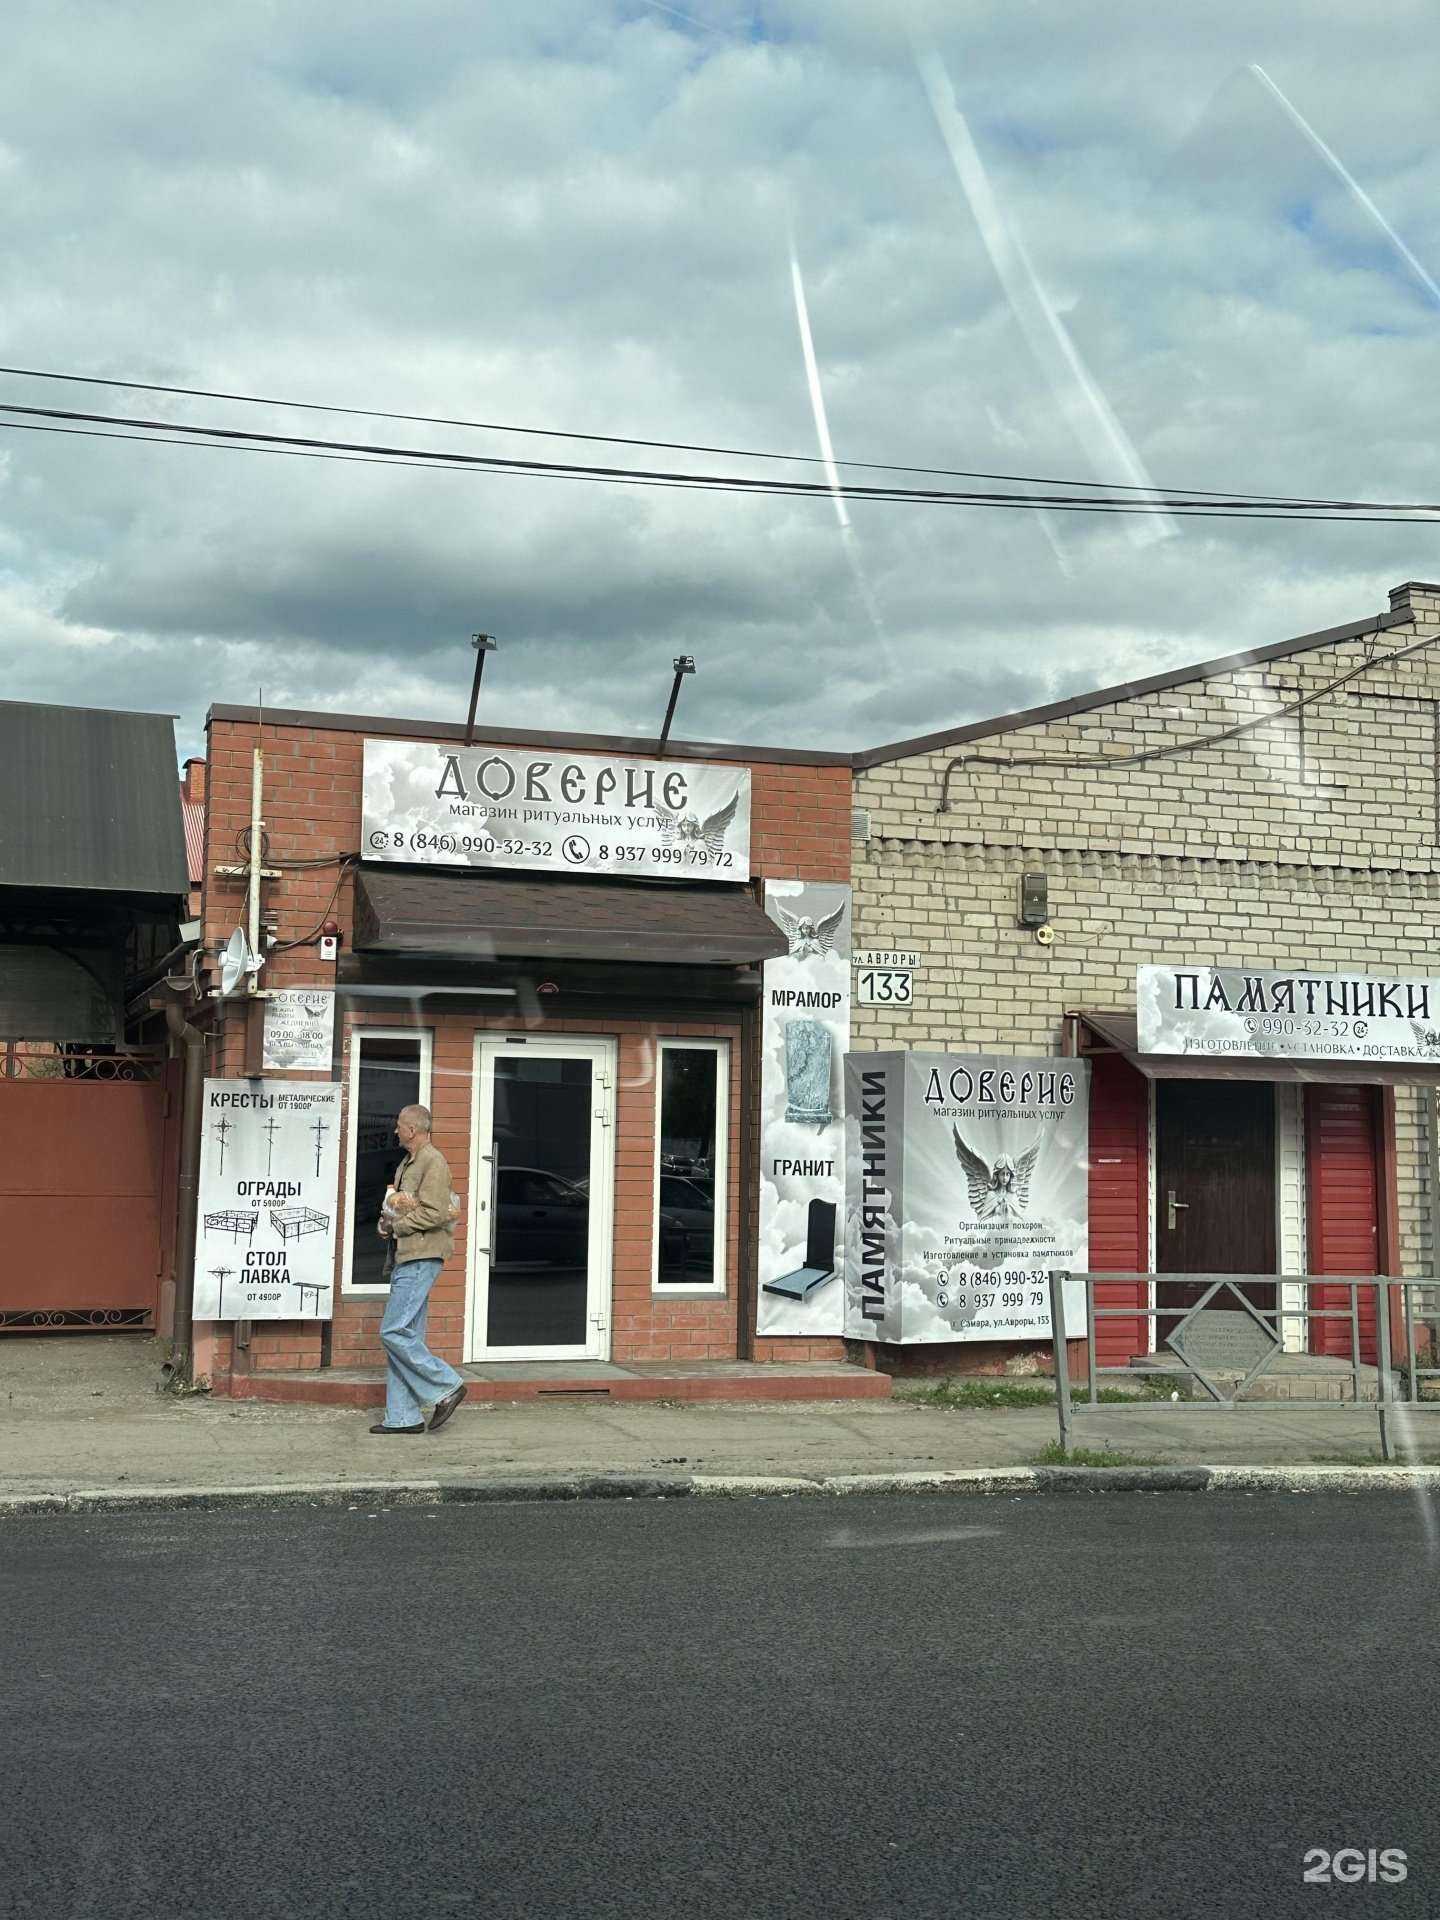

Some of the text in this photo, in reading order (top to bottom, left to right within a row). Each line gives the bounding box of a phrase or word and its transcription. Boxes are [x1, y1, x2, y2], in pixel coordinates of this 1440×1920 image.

[435, 755, 688, 810] ДОВЕРИЕ
[449, 803, 673, 832] магазин ритуальных услуг
[393, 832, 404, 848] 8
[409, 832, 457, 853] (846)
[462, 836, 553, 857] 990-32-32
[599, 844, 733, 867] 8 937 999 79 72
[867, 952, 916, 966] АВРОРЫ
[861, 971, 910, 1002] 133
[271, 992, 328, 1005] ОВЕРИЕ
[771, 989, 842, 1009] МРАМОР
[1173, 973, 1431, 1020] ПАМЯТНИКИ
[1262, 1017, 1349, 1038] 990-32-32
[1362, 1044, 1423, 1058] ДОСТАВКА
[924, 1066, 1075, 1105] ДОВЕРИЕ
[210, 1092, 274, 1109] КРЕСТЫ
[278, 1101, 288, 1109] ОТ
[933, 1106, 1066, 1122] магазин ритуальных услуг
[773, 1159, 835, 1177] ГРАНИТ
[237, 1181, 301, 1199] ОГРАДЫ
[861, 1071, 886, 1322] ПАМЯТНИКИ
[251, 1199, 261, 1207] ОТ
[959, 1220, 1043, 1232] Организация похорон
[944, 1235, 992, 1246] Ритуальные
[245, 1251, 287, 1266] СТОЛ
[923, 1250, 979, 1260] Изготовление
[991, 1249, 1029, 1260] установка
[239, 1268, 291, 1284] ЛАВКА
[959, 1272, 967, 1287] 8
[970, 1271, 1001, 1288] (846)
[247, 1293, 257, 1301] ОТ
[959, 1291, 1044, 1309] 8 937 999 79
[960, 1318, 992, 1328] Самара,
